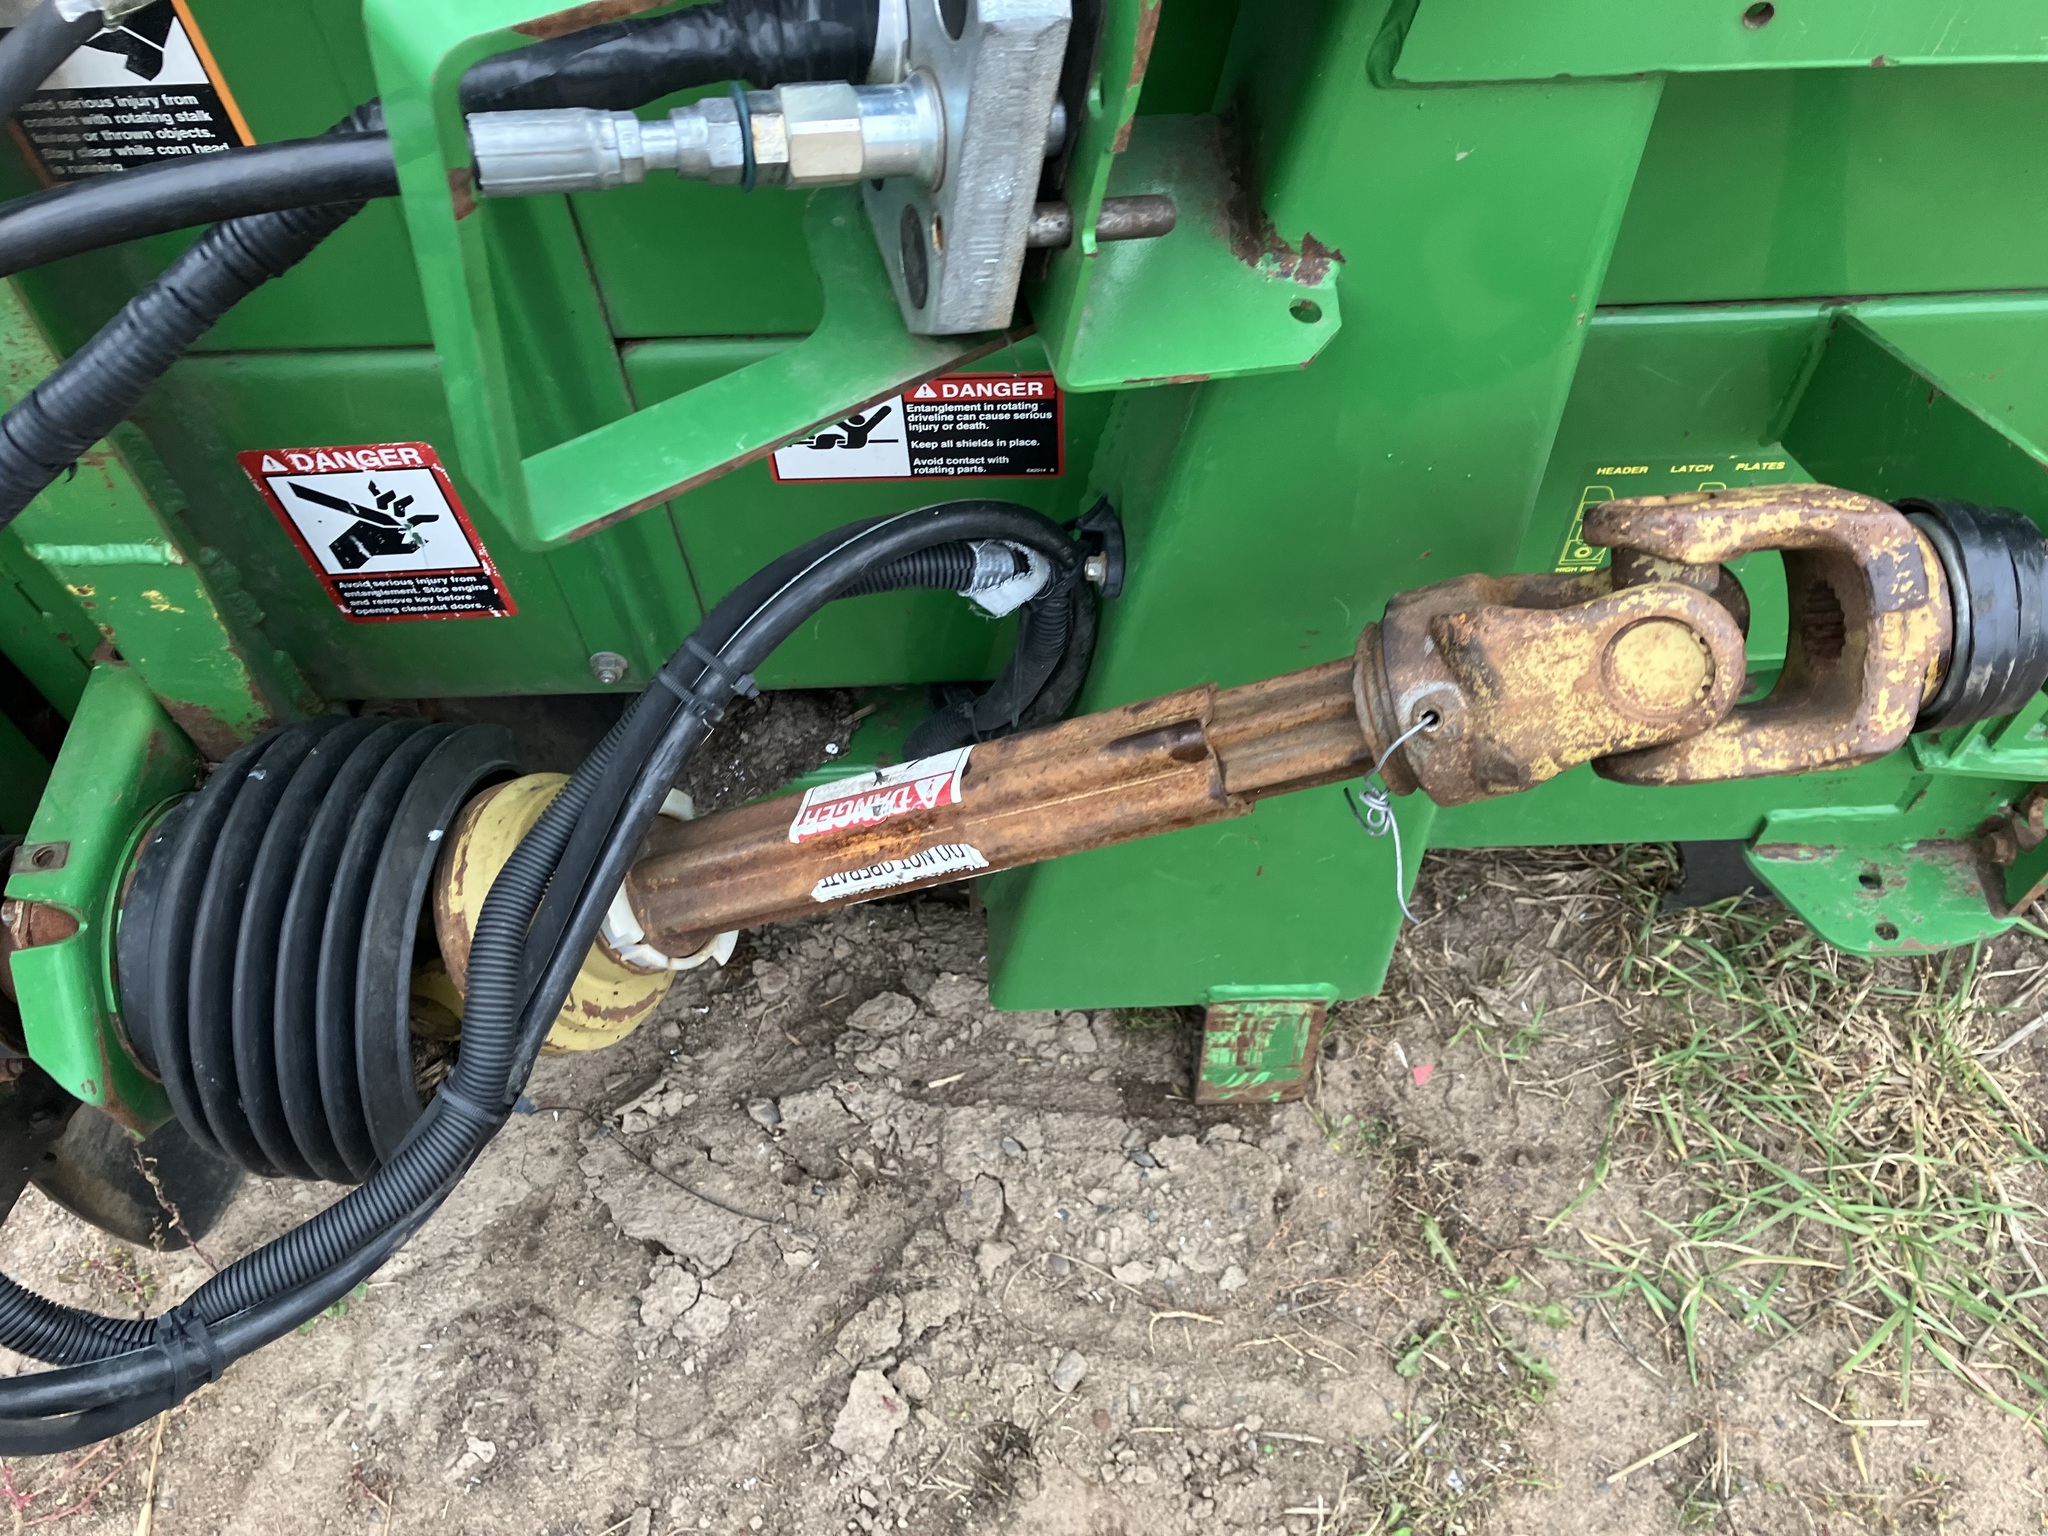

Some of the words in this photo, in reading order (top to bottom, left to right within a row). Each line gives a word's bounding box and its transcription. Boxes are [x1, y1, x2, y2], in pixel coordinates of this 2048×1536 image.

[57, 97, 114, 109] serious
[114, 95, 159, 109] injury
[161, 94, 199, 106] from
[80, 113, 112, 125] with
[114, 111, 175, 125] rotating
[175, 110, 213, 122] stalk
[82, 132, 98, 141] or
[100, 130, 153, 141] thrown
[155, 127, 216, 141] objects.
[114, 145, 154, 155] while
[156, 146, 192, 155] corn
[192, 143, 230, 154] head
[942, 382, 1044, 398] DANGER
[906, 403, 982, 414] Entanglement
[983, 402, 994, 412] in
[996, 402, 1038, 413] rotating
[907, 412, 954, 422] driveline
[956, 413, 977, 421] can
[978, 413, 1011, 421] cause
[1013, 411, 1052, 420] serious
[908, 422, 940, 432] injury
[942, 423, 954, 431] or
[956, 421, 989, 431] death.
[911, 440, 938, 450] Keep
[940, 439, 953, 448] all
[955, 439, 994, 448] shields
[996, 438, 1007, 448] in
[1009, 438, 1040, 449] place.
[288, 447, 424, 471] DANGER
[913, 457, 943, 466] Avoid
[945, 456, 985, 465] contact
[987, 456, 1009, 465] with
[914, 465, 955, 475] rotating
[957, 464, 987, 475] parts.
[1596, 466, 1648, 475] HEADER
[1670, 464, 1714, 473] LATCH
[1735, 461, 1786, 471] PLATES
[339, 580, 370, 589] Avoid
[372, 578, 414, 587] serious
[415, 577, 448, 586] injury
[450, 575, 477, 584] from
[343, 587, 421, 598] entanglement.
[422, 586, 449, 595] Stop
[451, 584, 489, 594] engine
[349, 598, 370, 607] and
[372, 597, 413, 606] remove
[415, 595, 434, 604] key
[355, 606, 400, 616] opening
[401, 604, 448, 613] cleanout
[450, 602, 485, 611] doors.
